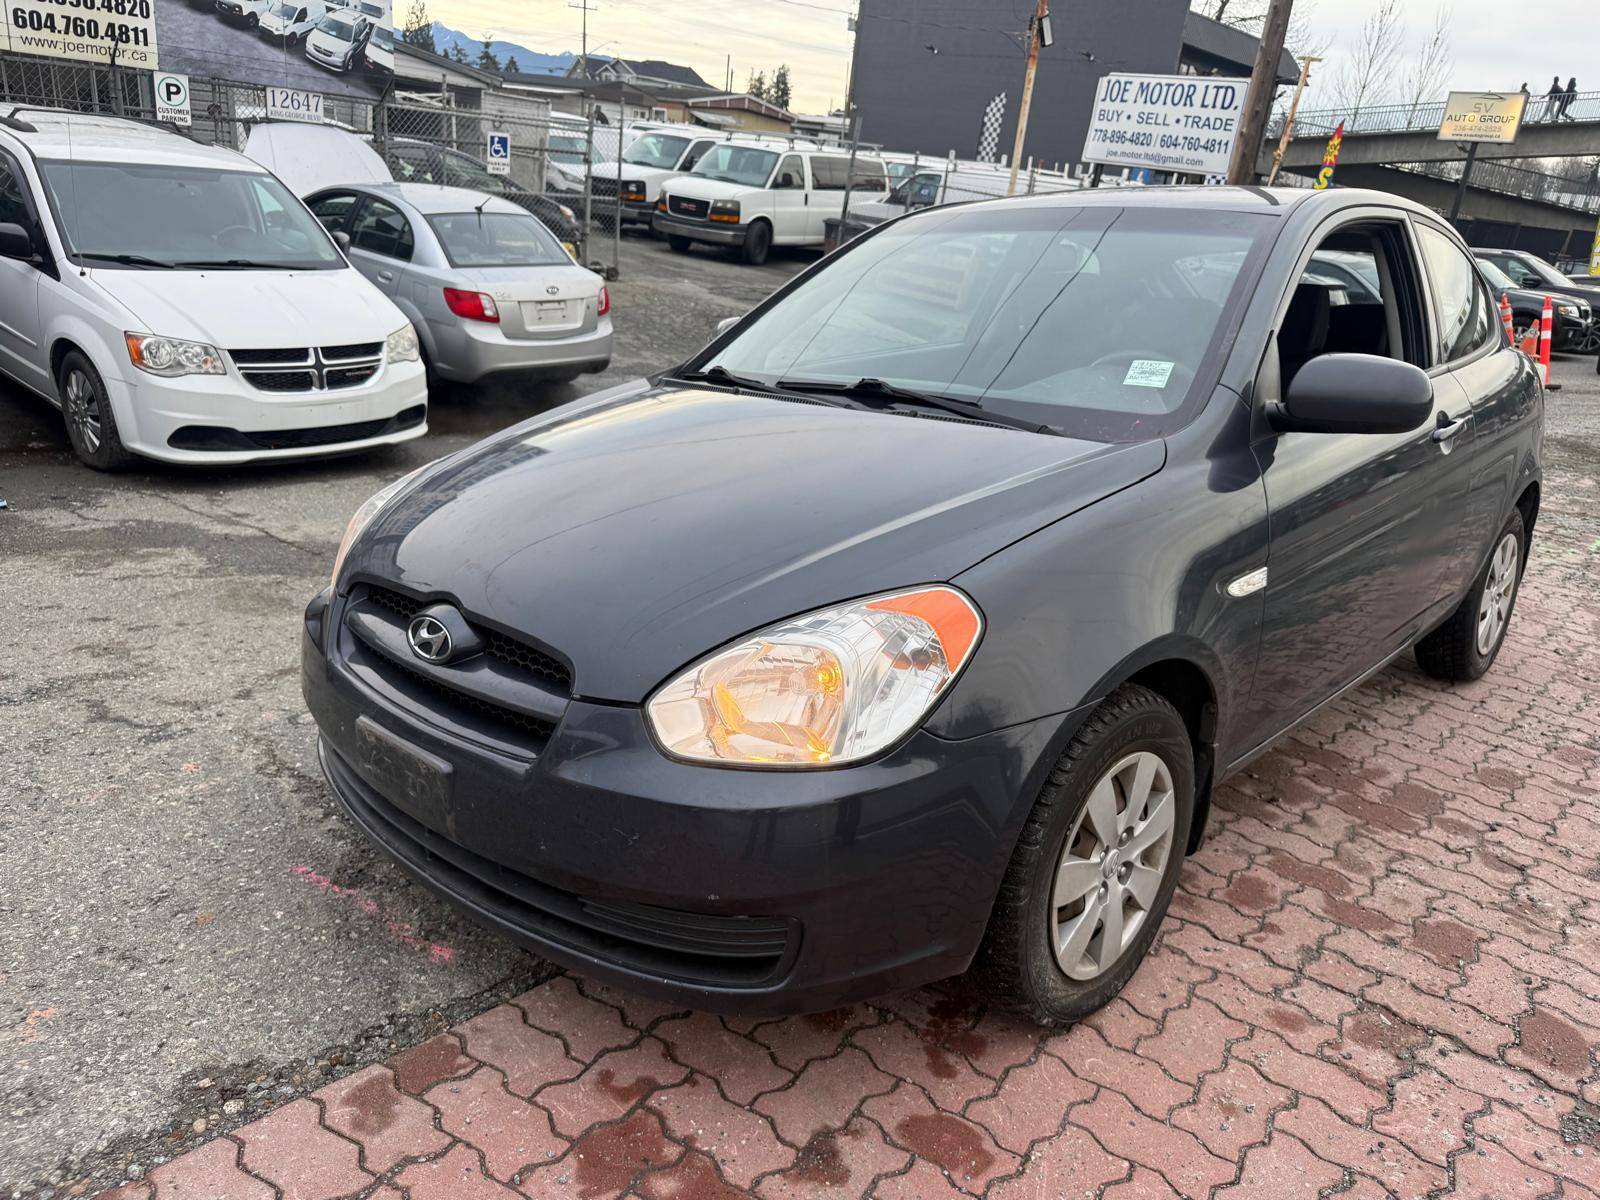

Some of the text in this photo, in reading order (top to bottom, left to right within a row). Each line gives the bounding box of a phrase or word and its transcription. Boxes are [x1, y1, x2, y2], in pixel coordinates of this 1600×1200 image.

[12, 7, 149, 47] 604.760.4811
[20, 35, 148, 62] www.joemotor.ca
[165, 82, 181, 101] P
[270, 89, 321, 113] 12647
[1101, 79, 1239, 111] JOE MOTOR LTD.
[158, 106, 190, 116] CUSTOMER
[161, 114, 188, 124] PARKING
[1446, 114, 1515, 123] AUTO GROUP
[1473, 103, 1494, 113] SV
[1098, 109, 1234, 131] BUY SELL TRADE
[1092, 129, 1153, 147] 778-896-4820
[1160, 133, 1230, 154] 604-760-4811
